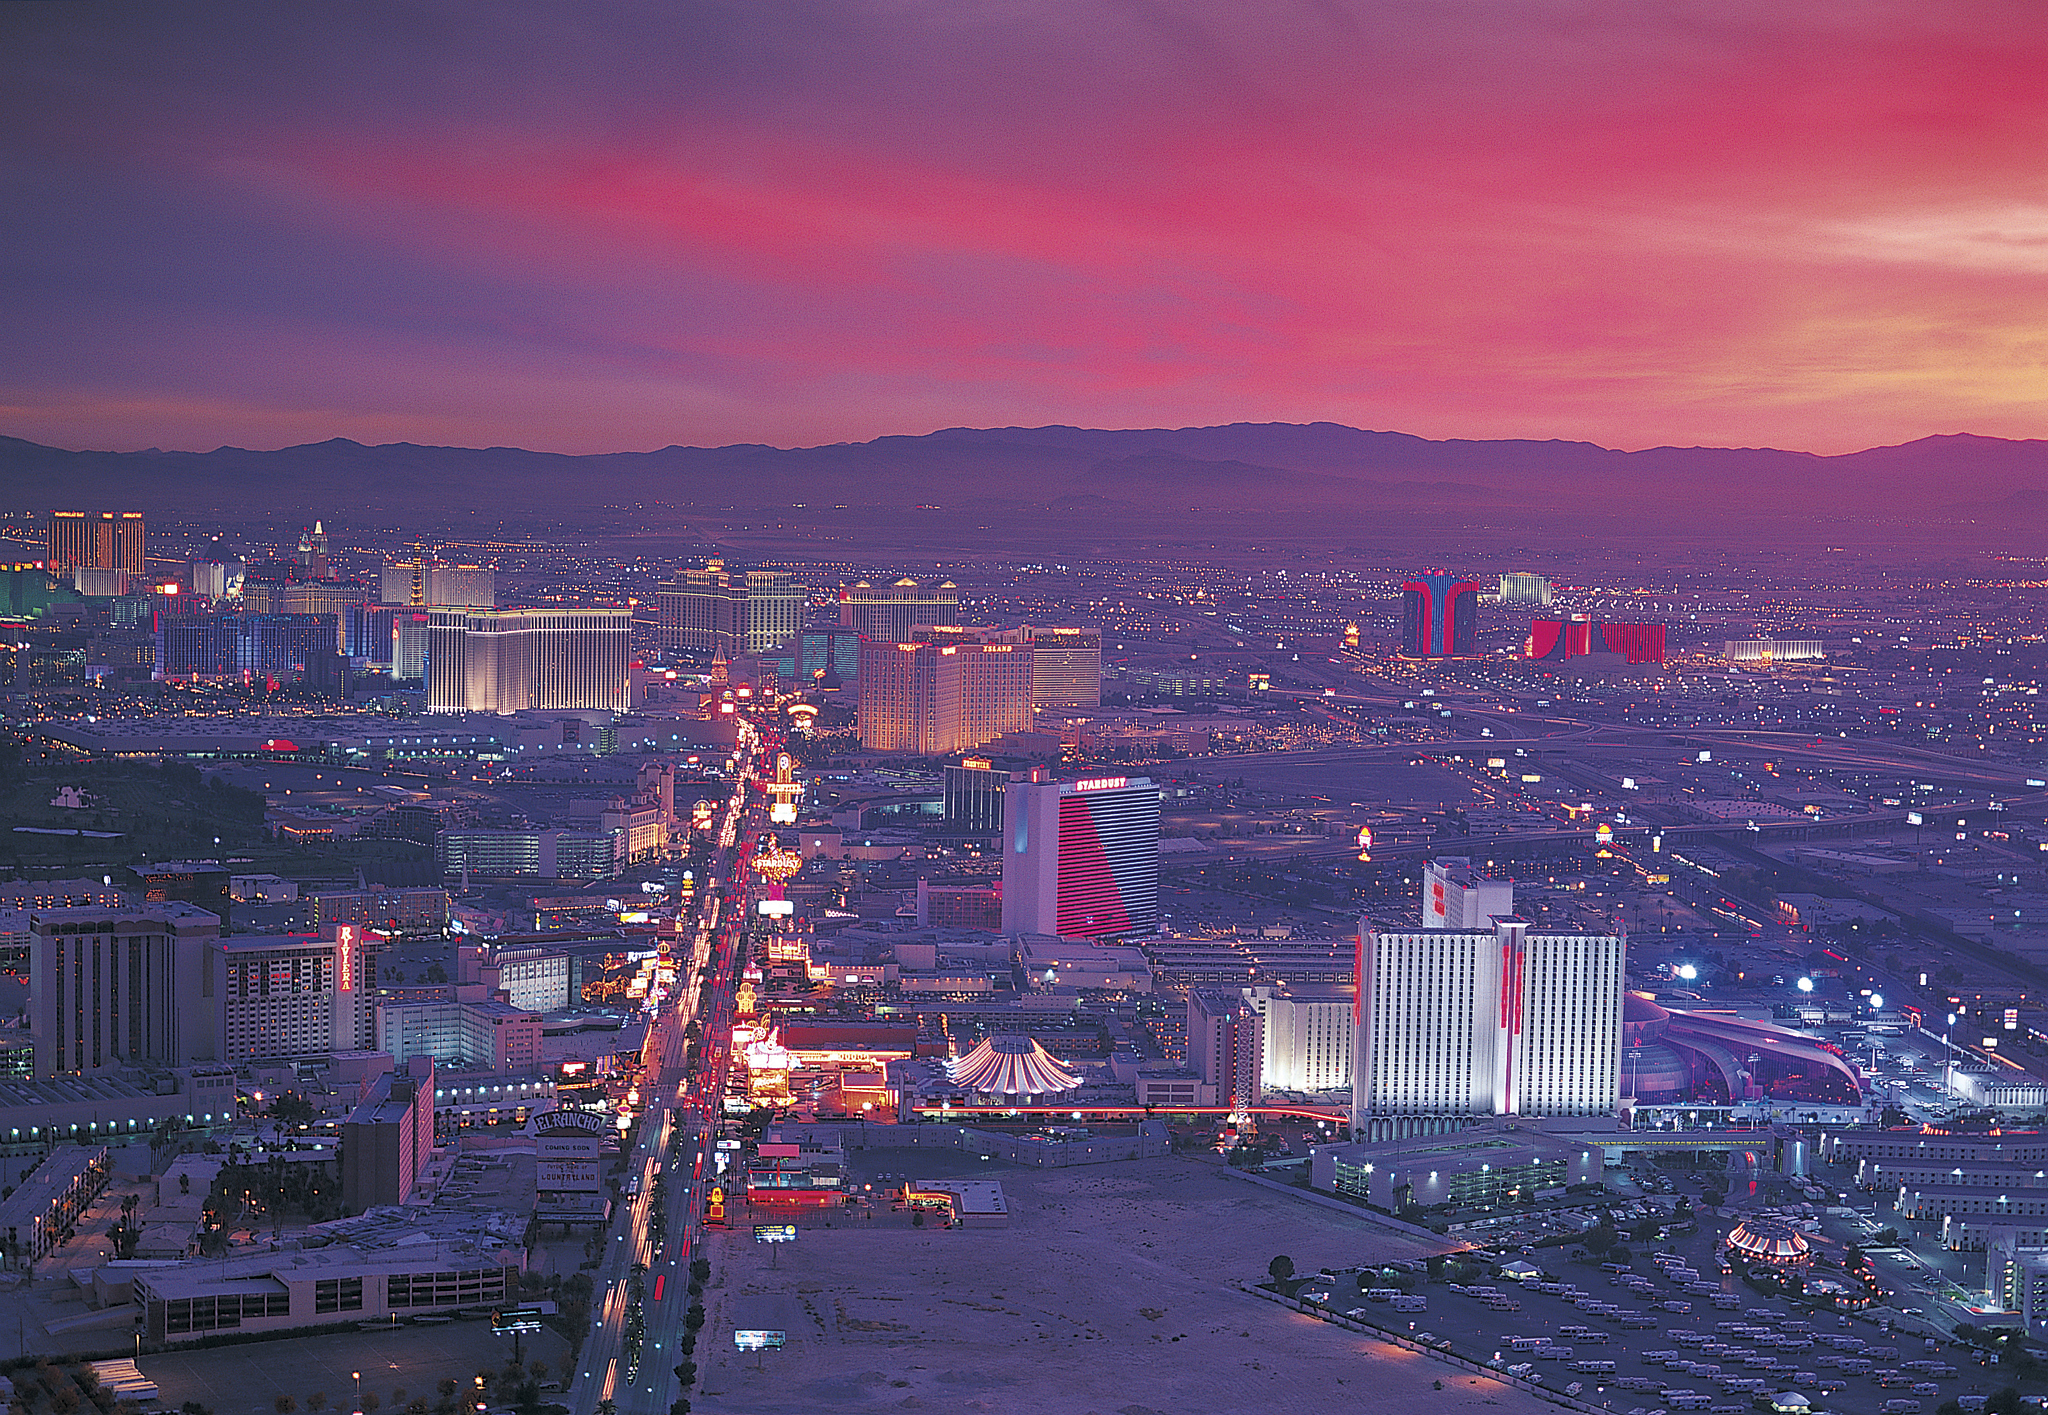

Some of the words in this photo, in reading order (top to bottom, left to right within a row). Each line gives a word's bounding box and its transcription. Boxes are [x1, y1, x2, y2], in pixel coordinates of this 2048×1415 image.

[983, 645, 1013, 653] ISLAND
[1076, 777, 1126, 791] STARDUST
[756, 858, 800, 869] STARDUST
[340, 926, 354, 990] RIVIERA
[536, 1115, 553, 1131] EL
[552, 1112, 600, 1132] RANCHO
